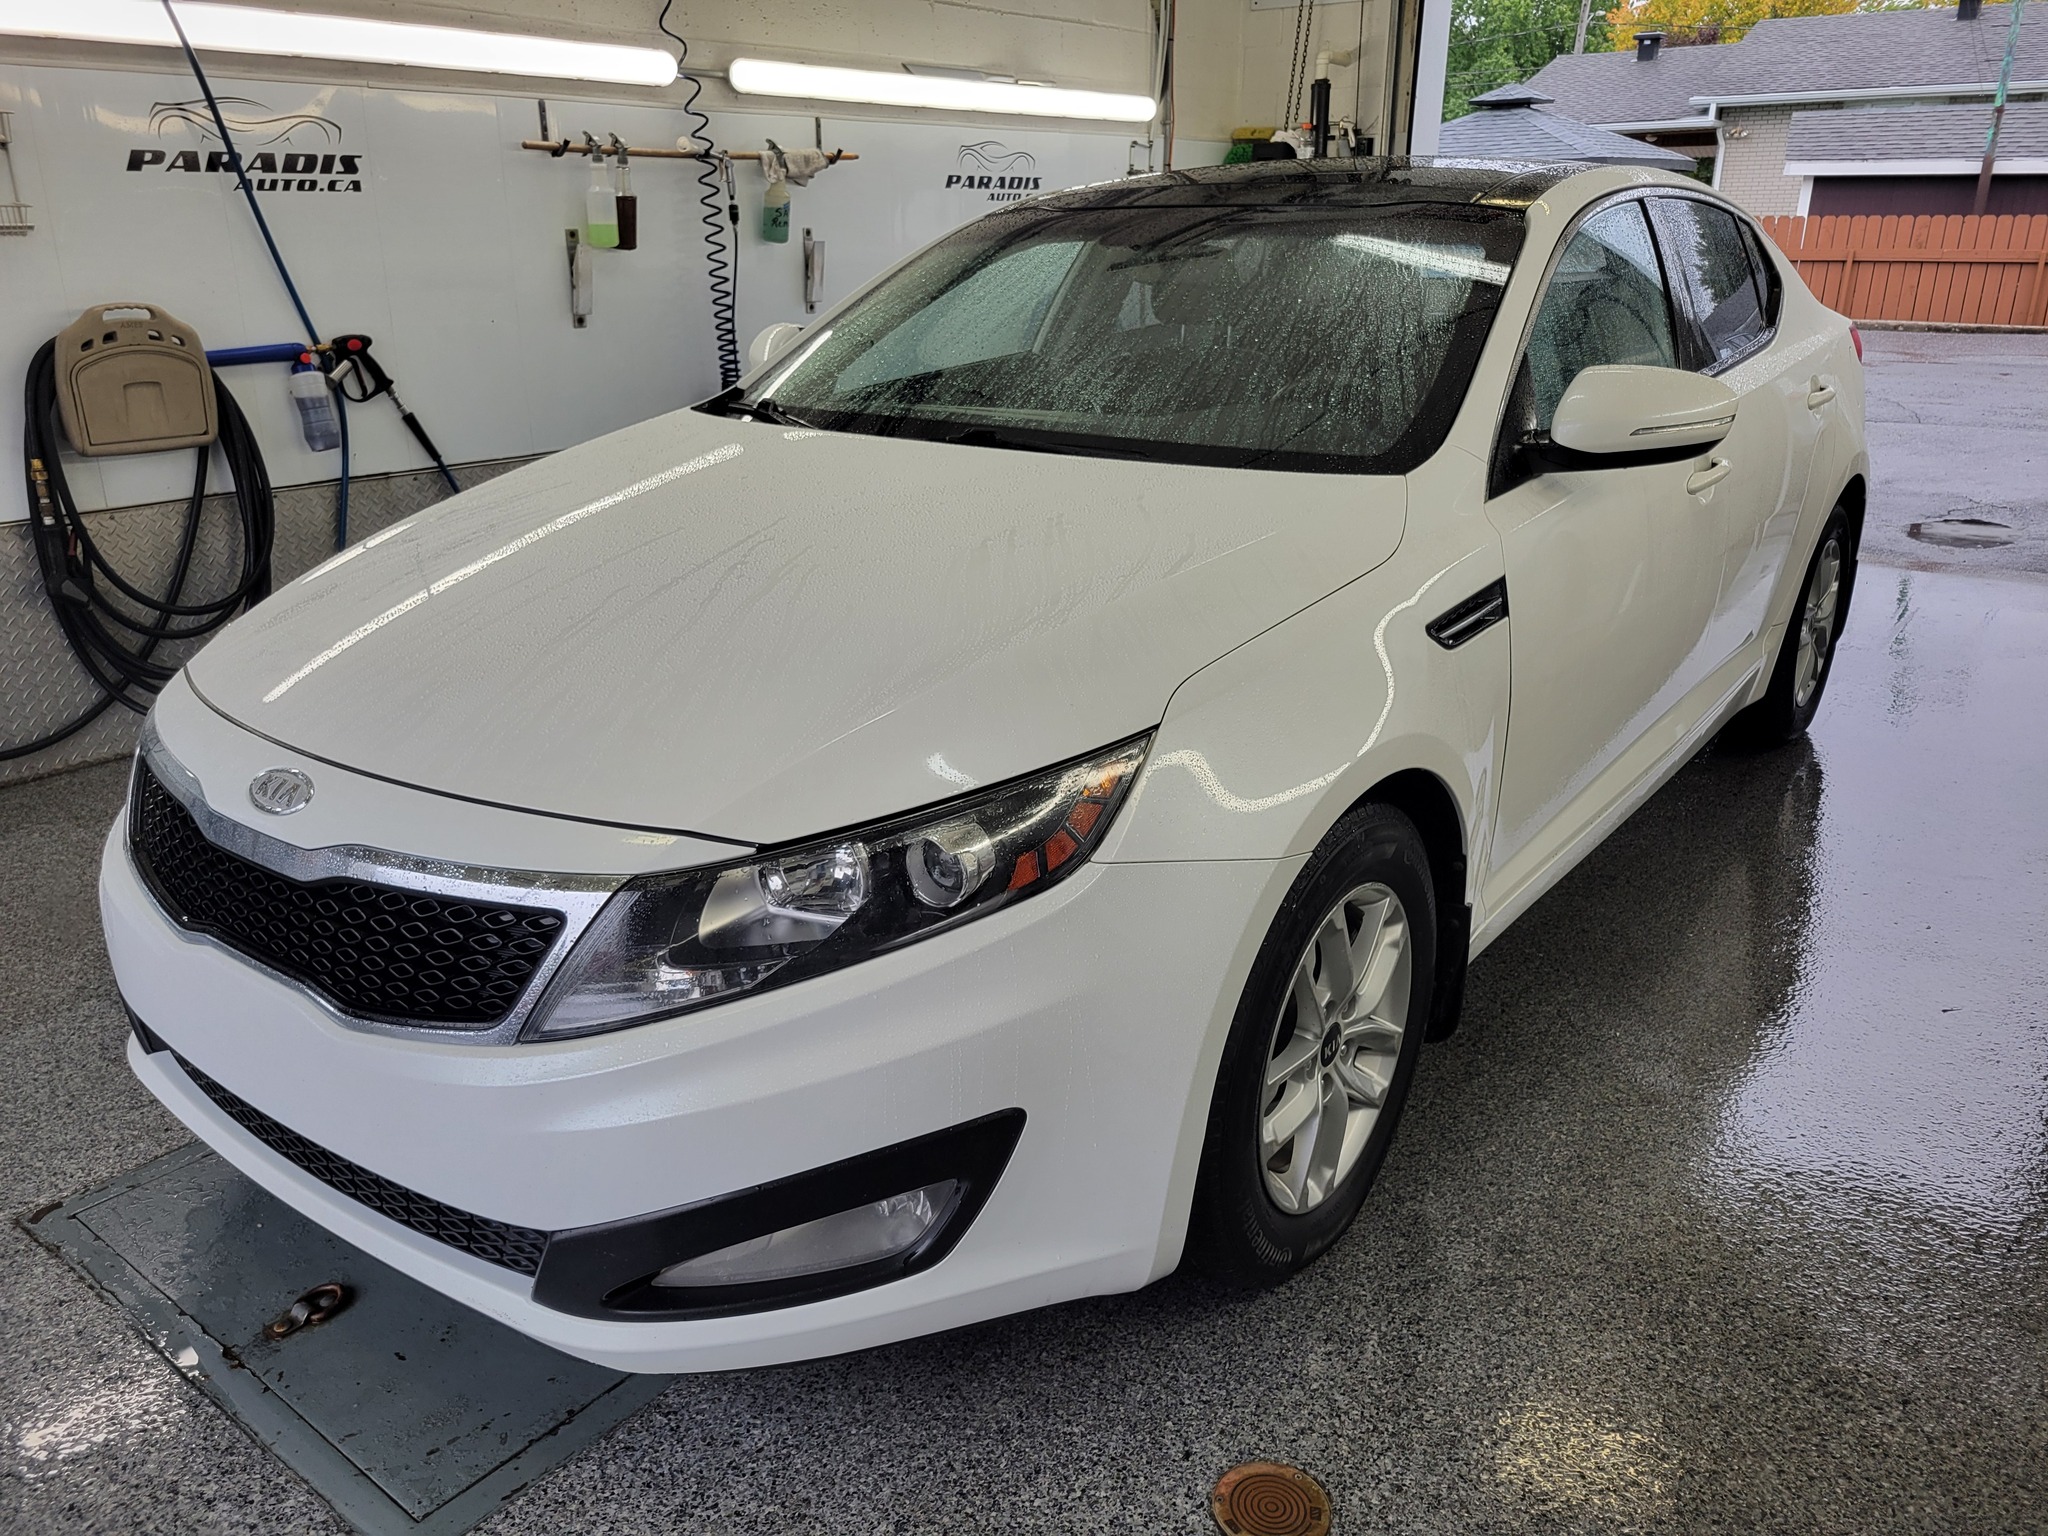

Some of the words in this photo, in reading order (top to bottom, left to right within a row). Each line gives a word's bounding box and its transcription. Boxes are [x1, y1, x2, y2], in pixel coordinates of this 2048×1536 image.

[126, 149, 362, 175] PARADIS
[233, 178, 362, 192] AUTO.CA
[945, 174, 1042, 190] PARADIS
[255, 774, 301, 808] KIA
[1324, 1034, 1341, 1059] KIA
